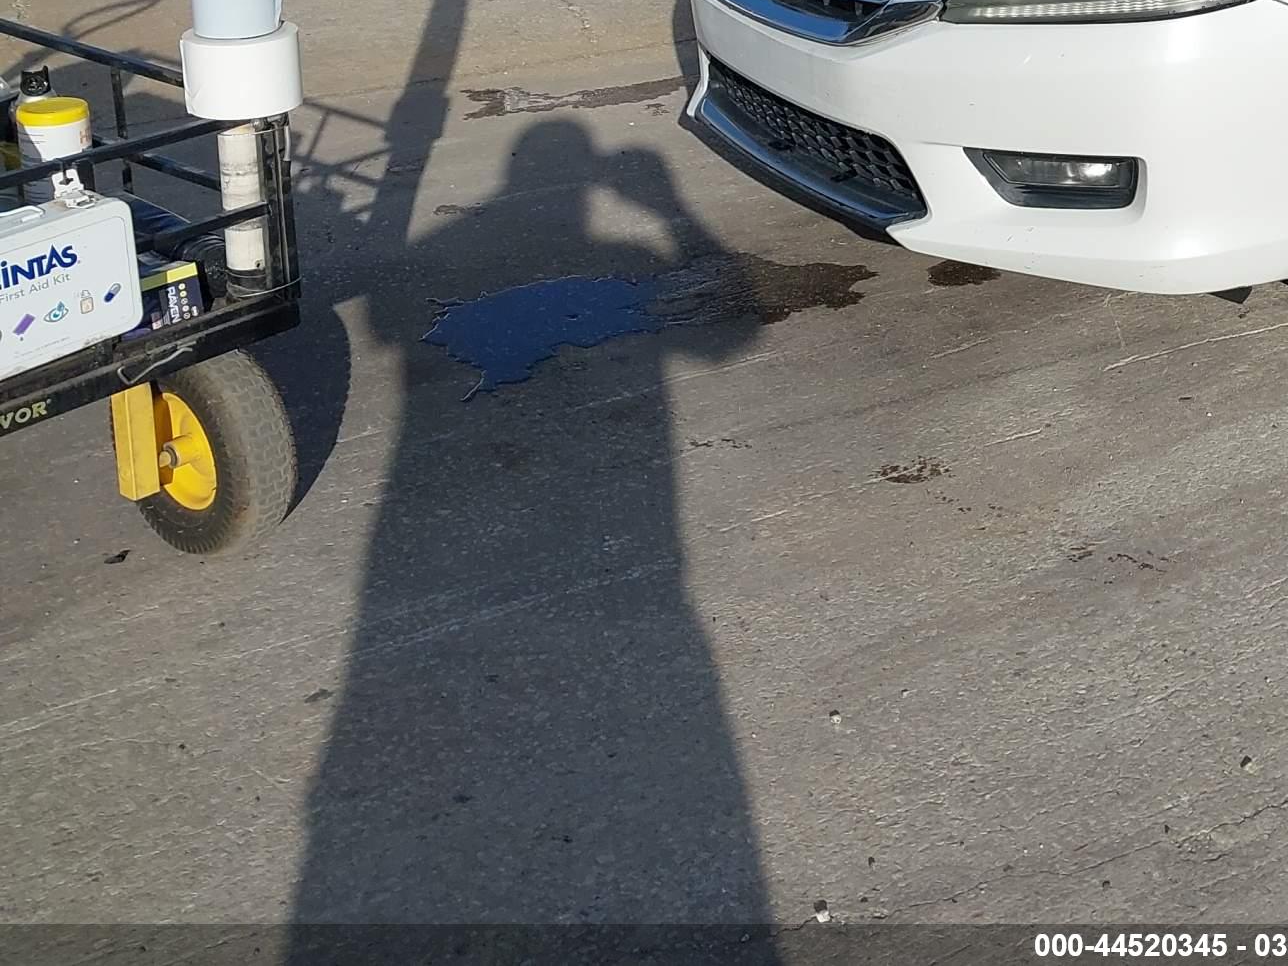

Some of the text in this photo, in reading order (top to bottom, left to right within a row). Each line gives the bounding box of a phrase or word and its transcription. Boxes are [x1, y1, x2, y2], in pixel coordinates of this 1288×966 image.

[29, 278, 49, 294] Aid
[53, 273, 71, 285] Kit
[166, 286, 182, 324] RAVEN
